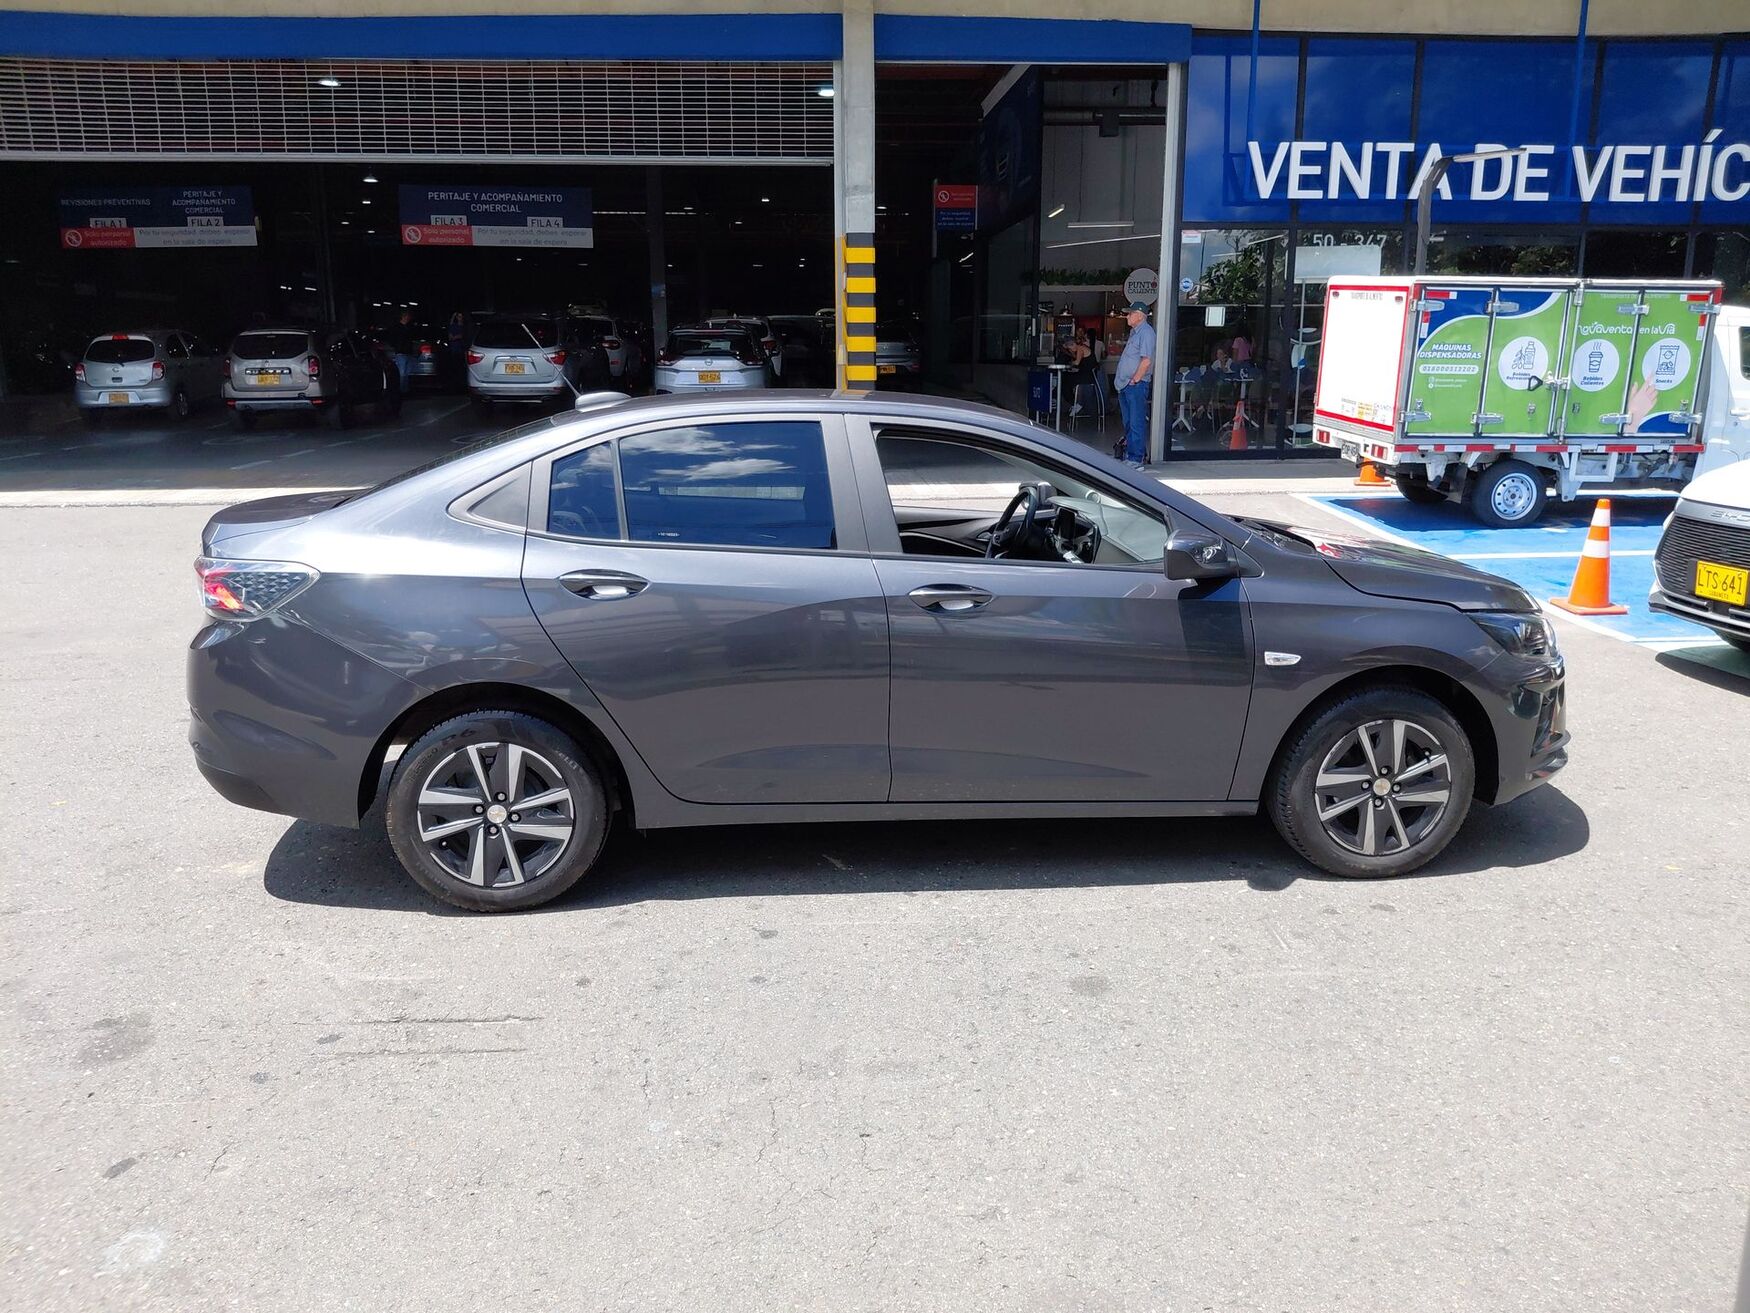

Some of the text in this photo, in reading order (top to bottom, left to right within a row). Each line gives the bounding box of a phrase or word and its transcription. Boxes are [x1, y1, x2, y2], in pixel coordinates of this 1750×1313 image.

[1248, 128, 1750, 202] VENTA DE VEHÍC
[427, 191, 563, 203] PERITAJE Y ACOMPAÑAMIENTO
[470, 203, 522, 213] COMERCIAL
[95, 220, 117, 228] FILA
[191, 219, 213, 227] FILA
[435, 217, 464, 225] FILA 3
[531, 219, 560, 227] FILA 4
[1313, 233, 1334, 246] 50
[1127, 279, 1158, 289] PUNTO
[1419, 351, 1482, 359] DISPENSADORAS
[1698, 568, 1742, 595] LTS 641
